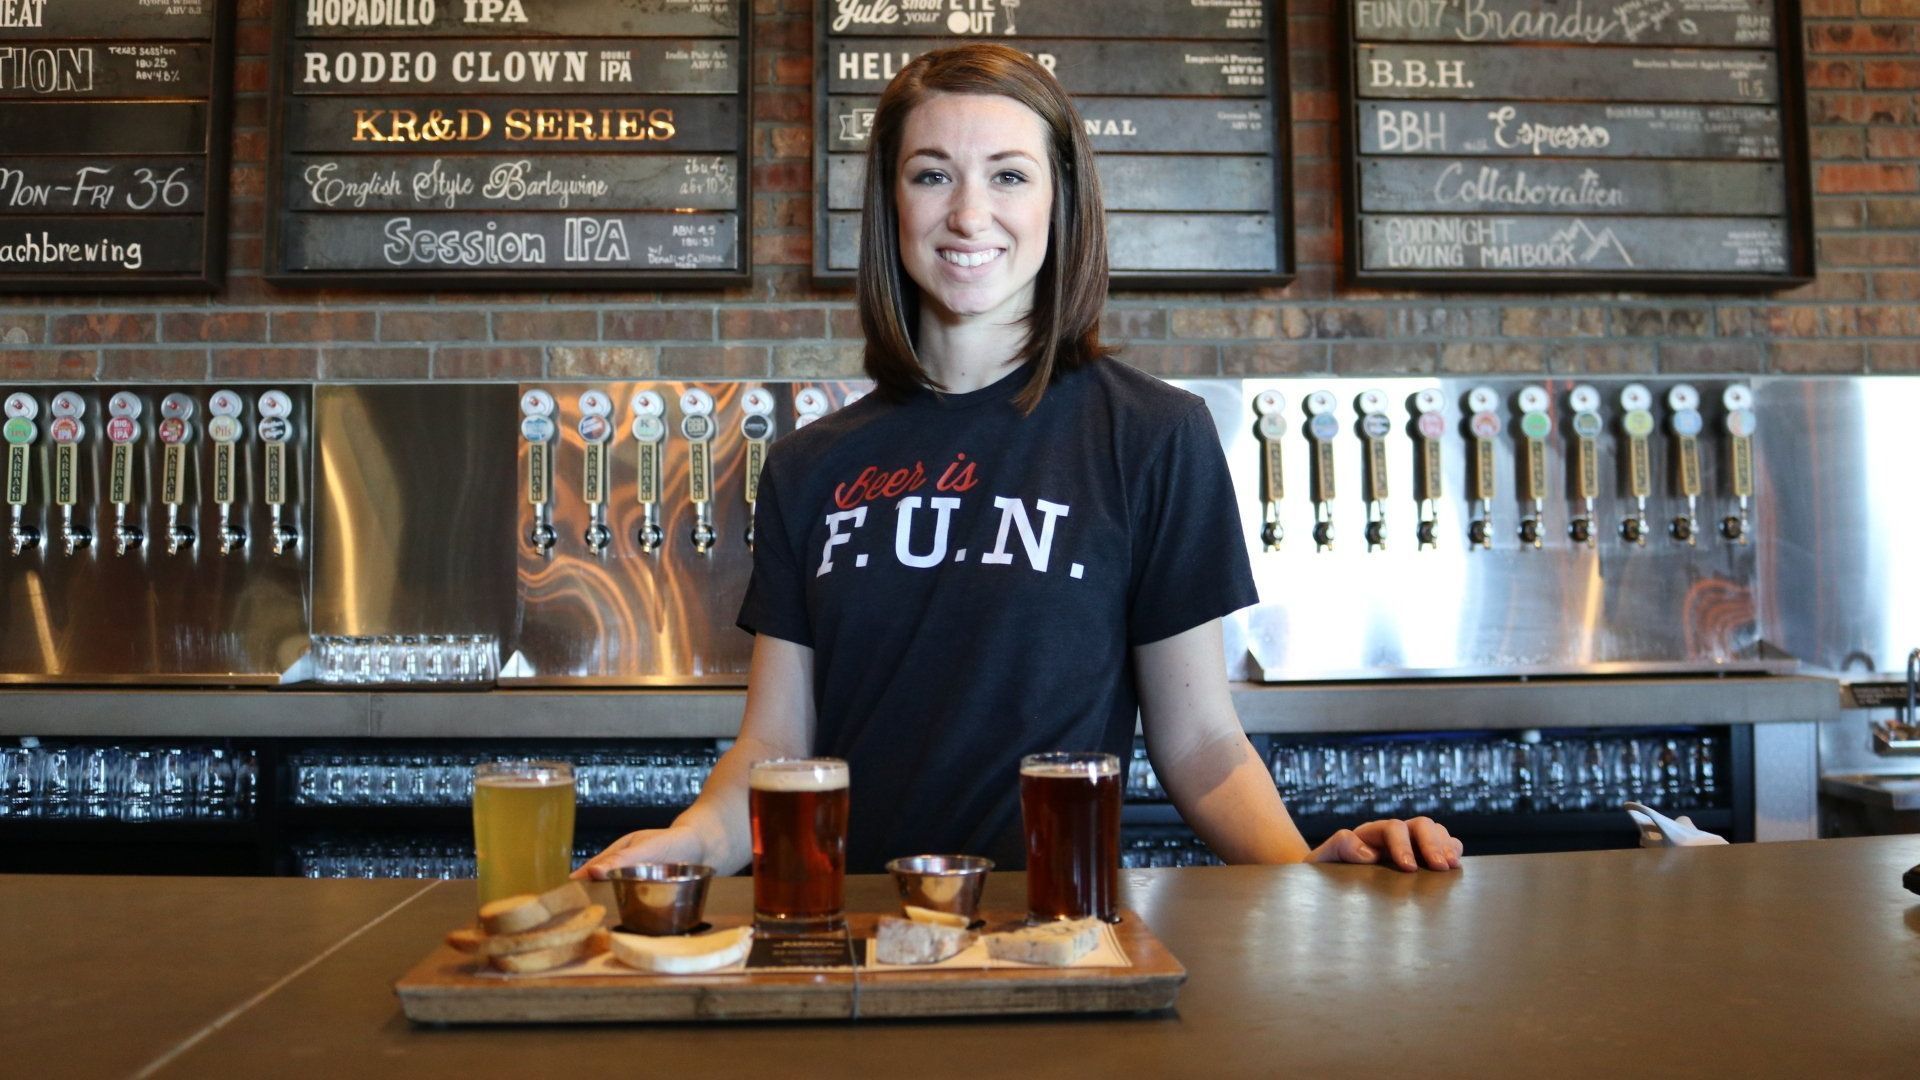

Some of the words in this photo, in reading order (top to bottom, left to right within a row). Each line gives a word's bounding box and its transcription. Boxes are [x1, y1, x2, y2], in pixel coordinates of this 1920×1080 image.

[307, 0, 436, 26] HOPADILLO
[463, 0, 528, 23] IPA
[947, 11, 996, 34] OUT
[1358, 0, 1402, 28] FUN
[1455, 0, 1618, 43] Brandy
[154, 58, 168, 69] 25
[303, 51, 437, 83] RODEO
[452, 51, 588, 83] CLOWN
[600, 51, 632, 60] DOUBLE
[600, 60, 632, 82] IPA
[1370, 59, 1475, 88] B.B.H.
[352, 108, 493, 142] KR&D
[505, 108, 676, 141] SERIES
[1377, 110, 1446, 151] BBH
[1488, 106, 1610, 155] Espresso
[304, 163, 402, 207] English
[413, 159, 475, 209] Style
[482, 160, 608, 208] Barleywine
[1434, 162, 1622, 206] Collaboration
[0, 231, 142, 269] achbrewing
[383, 217, 546, 266] Session
[564, 217, 630, 261] IPA
[1385, 218, 1516, 247] GOODNIGHT
[1387, 245, 1464, 267] LOVING
[1480, 244, 1575, 268] MAIBOCK
[12, 447, 22, 500] KARBACH
[60, 447, 70, 500] KARBACH
[115, 447, 125, 500] KARBACH
[167, 447, 177, 500] KARBACH
[835, 463, 928, 509] Beer
[936, 453, 978, 492] is
